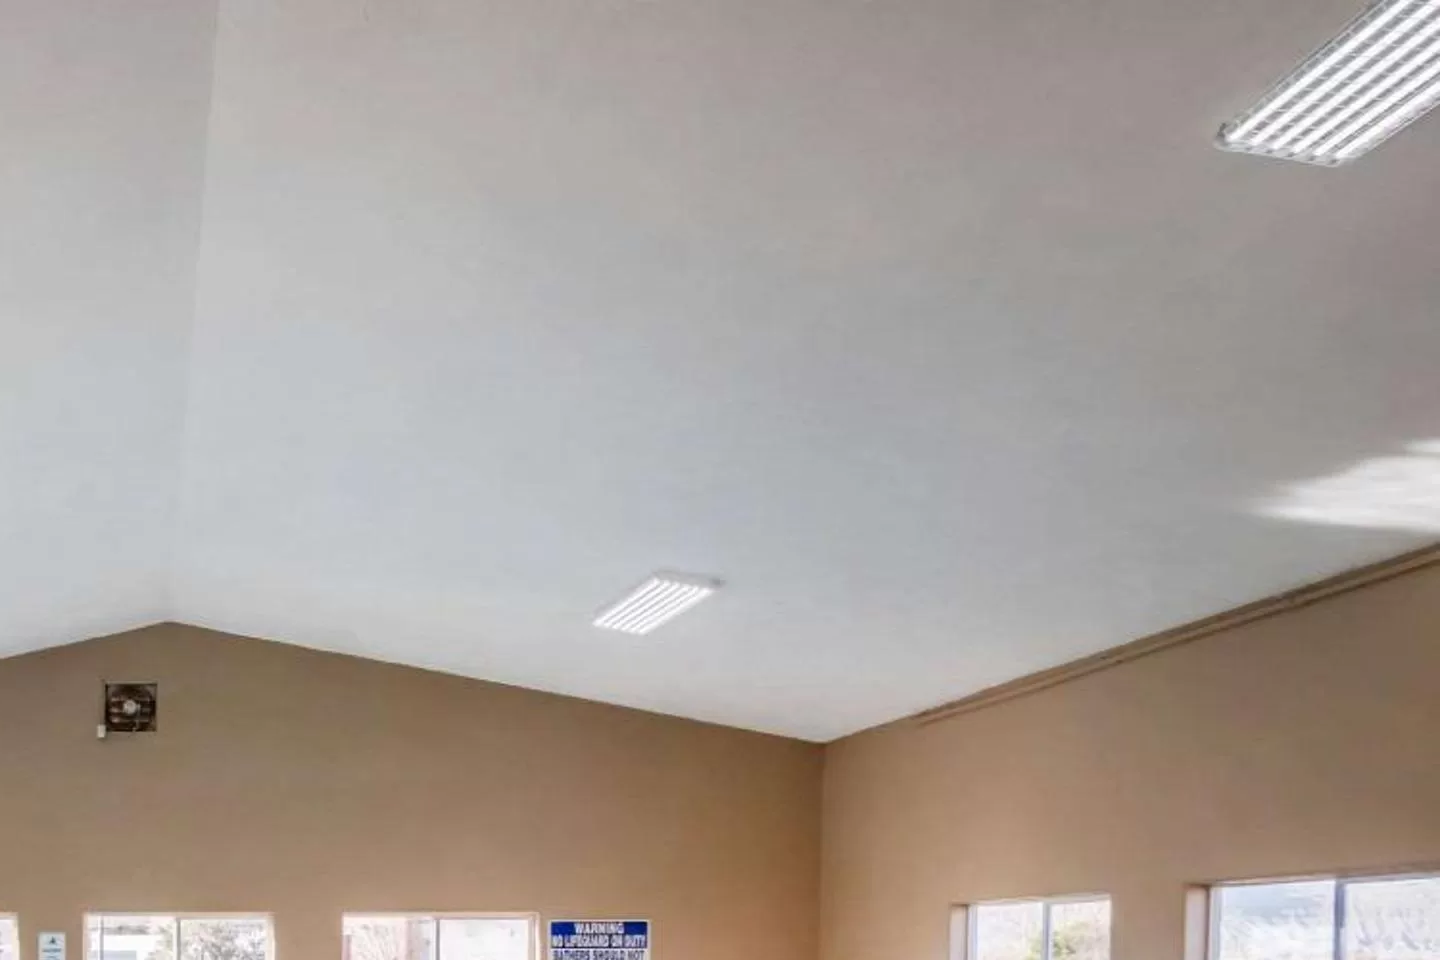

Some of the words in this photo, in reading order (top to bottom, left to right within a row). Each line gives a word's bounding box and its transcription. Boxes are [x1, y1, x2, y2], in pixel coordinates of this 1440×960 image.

[574, 922, 624, 934] WARNING
[564, 935, 609, 947] LIFEGUARD
[611, 935, 623, 947] ON
[553, 950, 590, 960] BATHERS
[593, 950, 625, 960] SHOULD
[627, 950, 645, 960] NOT
